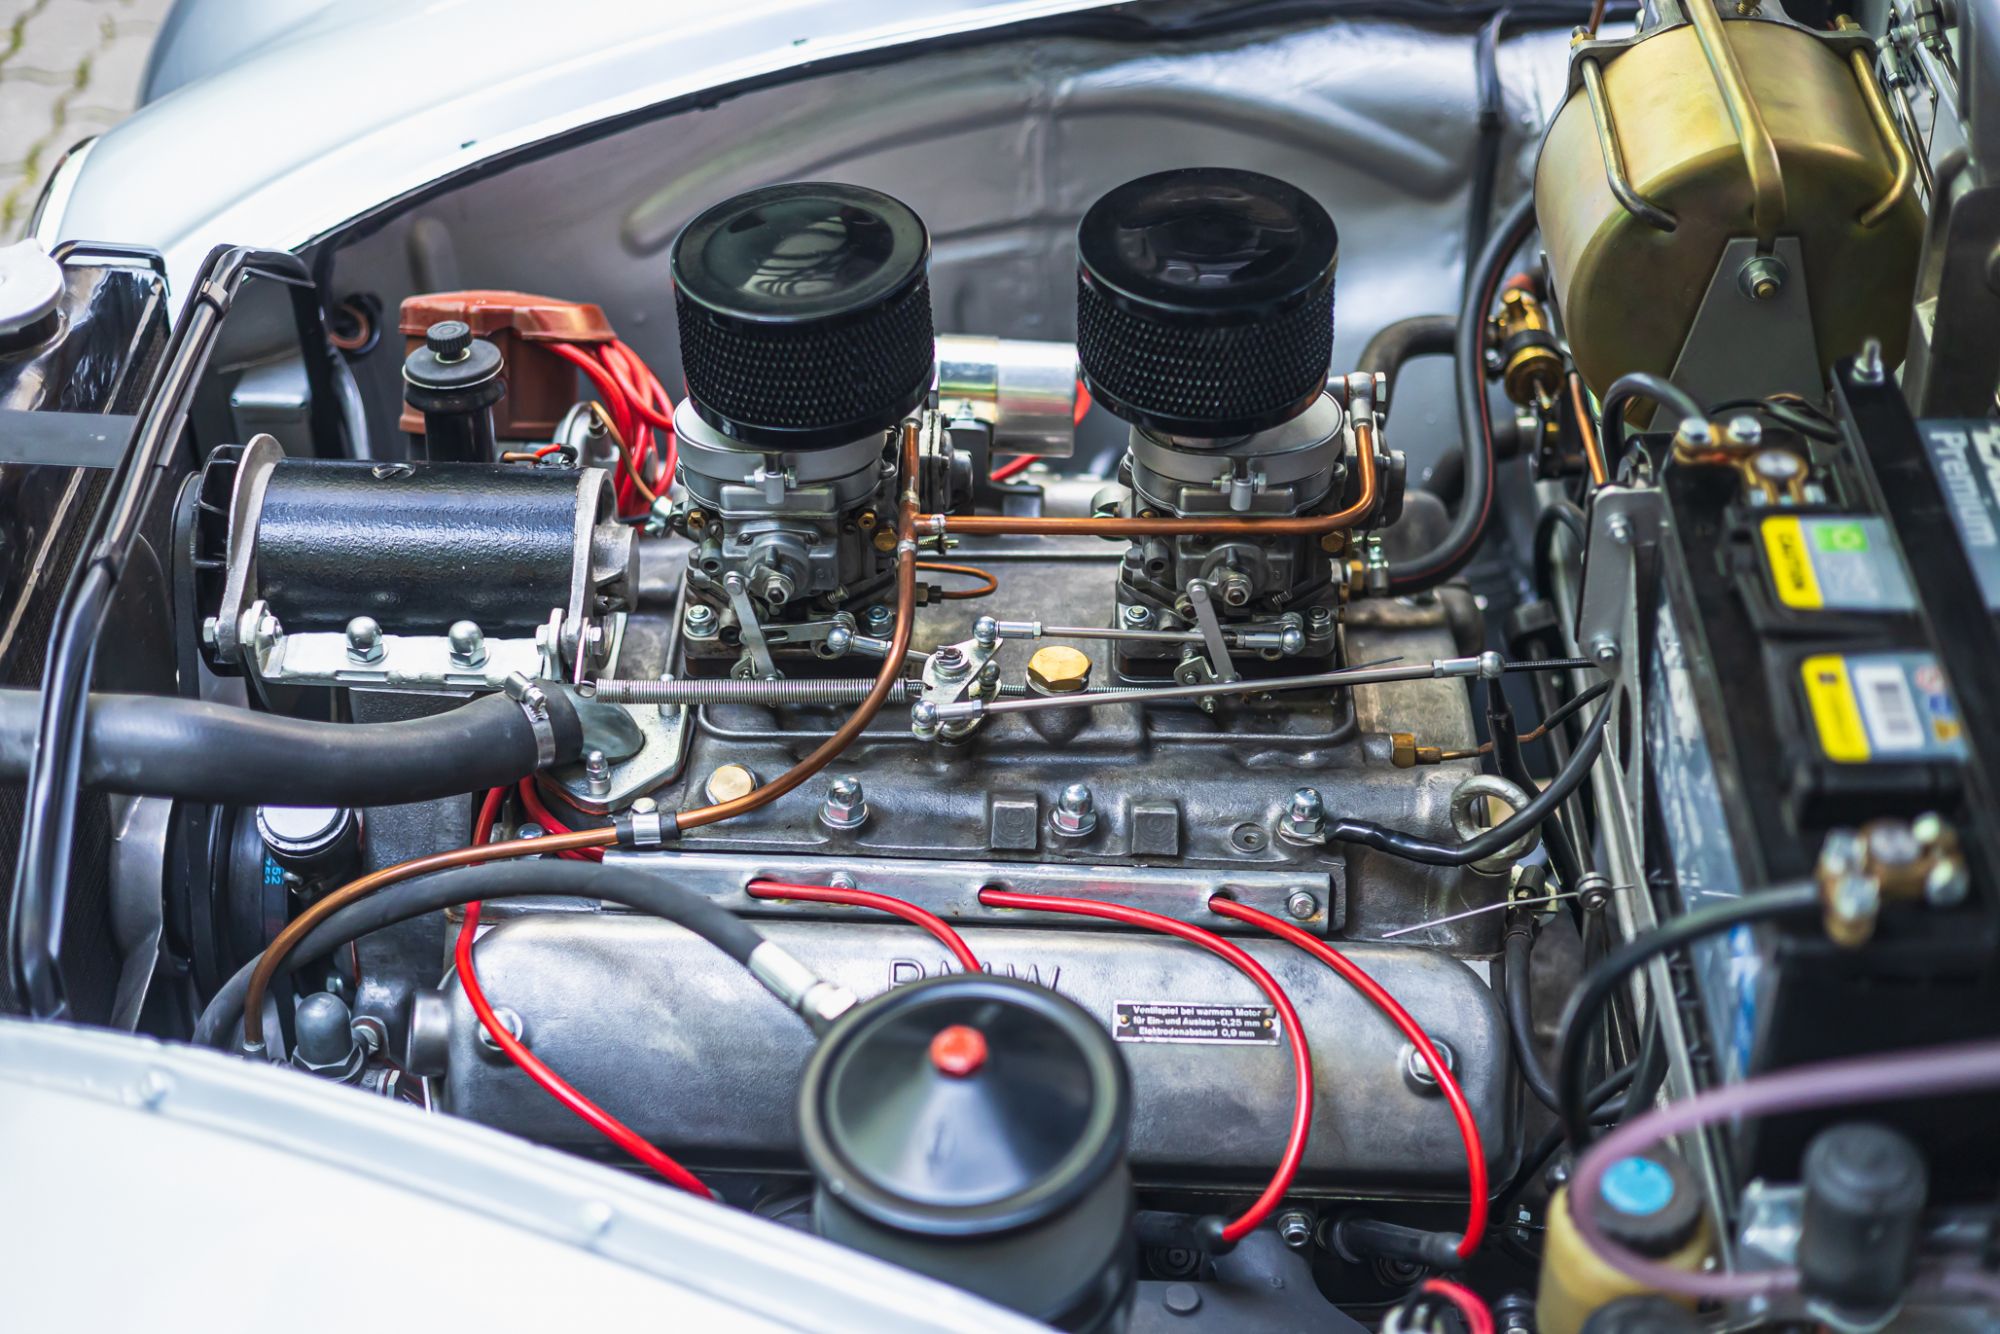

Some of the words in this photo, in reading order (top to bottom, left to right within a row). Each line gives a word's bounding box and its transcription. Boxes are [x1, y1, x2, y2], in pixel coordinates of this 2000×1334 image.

[1928, 431, 1998, 546] Premium
[1132, 1005, 1179, 1016] Ventilspiel
[1180, 1006, 1195, 1016] bei
[1196, 1009, 1234, 1017] warmem
[1235, 1008, 1262, 1018] Motor
[1132, 1016, 1146, 1026] für
[1146, 1017, 1164, 1026] Ein-
[1165, 1017, 1181, 1026] und
[1243, 1020, 1261, 1028] mm
[1138, 1026, 1218, 1038] Elektrodenabstand
[1238, 1030, 1256, 1038] mm
